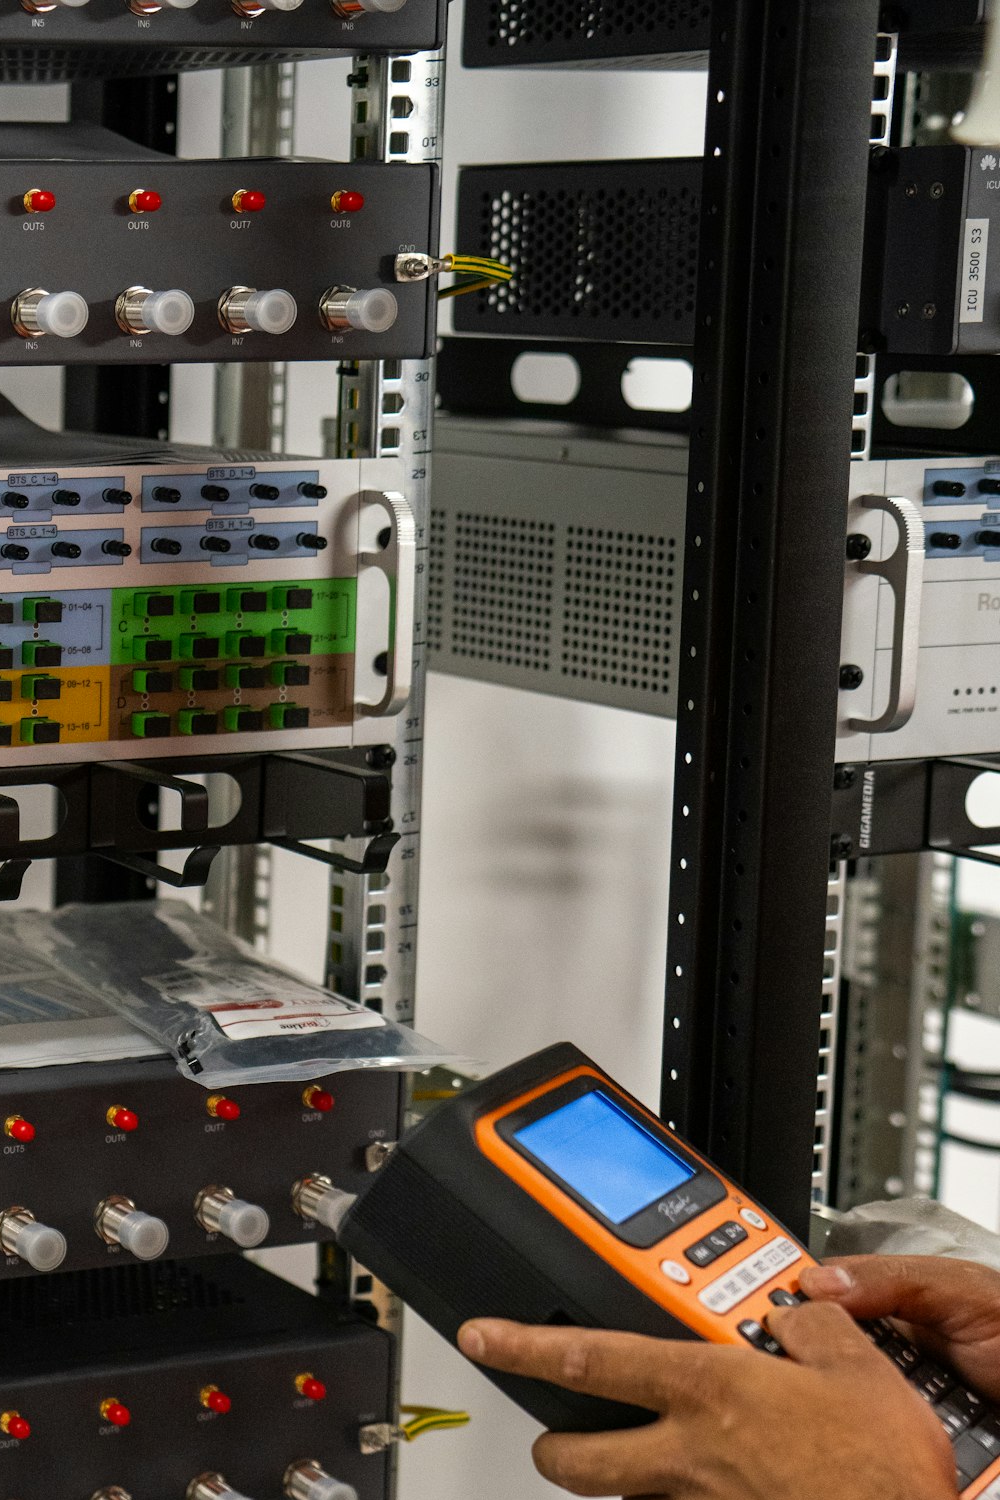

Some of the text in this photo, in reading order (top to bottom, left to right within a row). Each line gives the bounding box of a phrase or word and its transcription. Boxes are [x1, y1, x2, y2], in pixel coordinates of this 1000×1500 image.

[32, 18, 44, 28] IN5
[138, 19, 150, 28] IN6
[241, 20, 253, 30] IN7
[342, 22, 354, 30] IN8
[424, 77, 440, 87] 33
[422, 136, 437, 148] 10
[22, 222, 44, 231] OUT5
[127, 221, 148, 230] OUT6
[230, 220, 250, 230] OUT7
[330, 220, 350, 229] OUT8
[966, 228, 982, 312] ICU 3500 S3
[128, 339, 142, 348] IN6
[230, 337, 244, 346] IN7
[331, 335, 343, 344] IN8
[24, 341, 37, 350] IN5
[414, 372, 429, 382] 30
[412, 430, 427, 440] 13
[412, 469, 426, 480] 29
[68, 603, 92, 611] 01~04
[118, 620, 128, 632] C
[68, 646, 91, 654] 05~08
[66, 680, 90, 688] 09~12
[117, 696, 126, 708] D
[66, 722, 90, 731] 13~16
[860, 770, 875, 848] GIGAMEDIA
[280, 1020, 318, 1030] BizLine
[204, 1123, 225, 1132] OUT7
[105, 1134, 126, 1144] OUT6
[4, 1145, 25, 1155] OUT5
